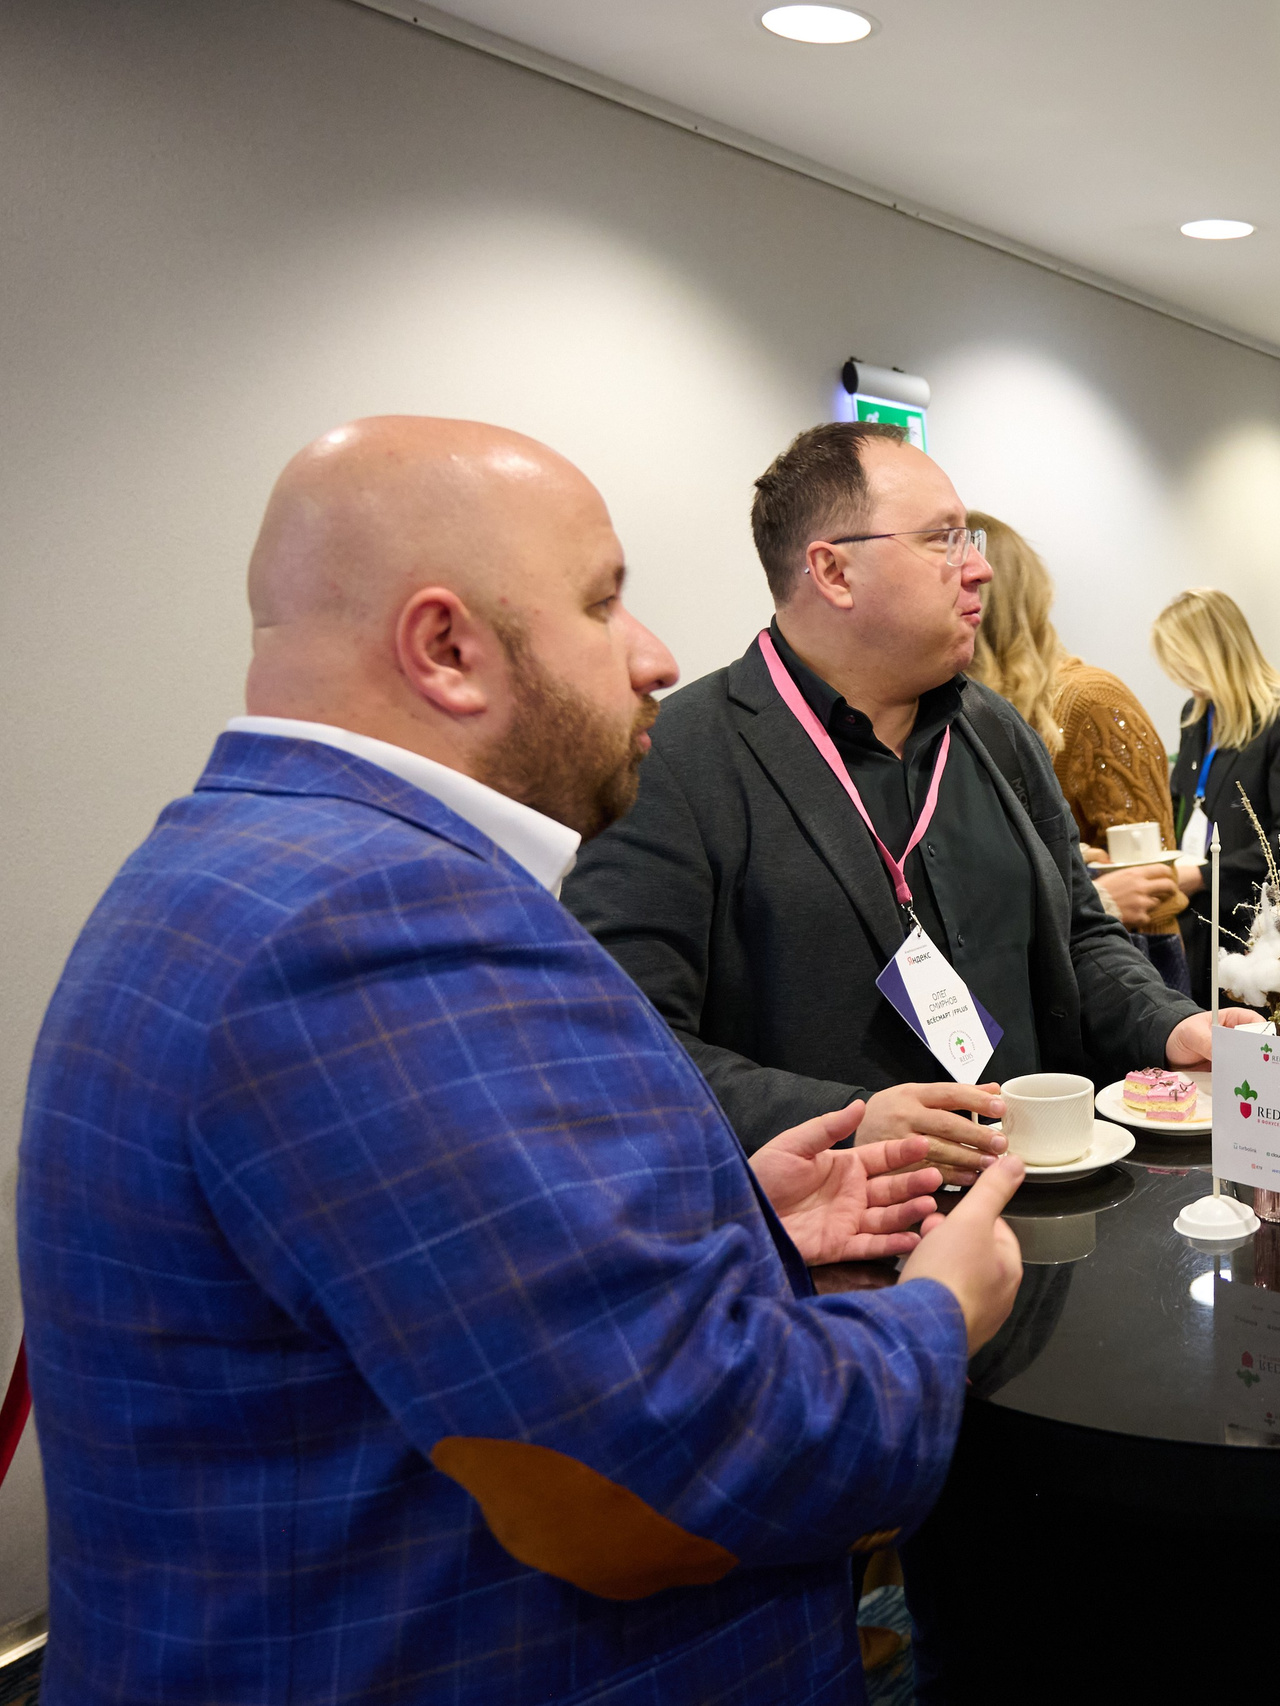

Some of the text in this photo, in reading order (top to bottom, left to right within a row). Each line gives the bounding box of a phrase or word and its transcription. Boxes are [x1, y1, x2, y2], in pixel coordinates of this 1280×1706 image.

[907, 951, 932, 966] Яндекс
[931, 988, 948, 1001] ОЛЕГ
[928, 996, 958, 1012] СМИРНОВ
